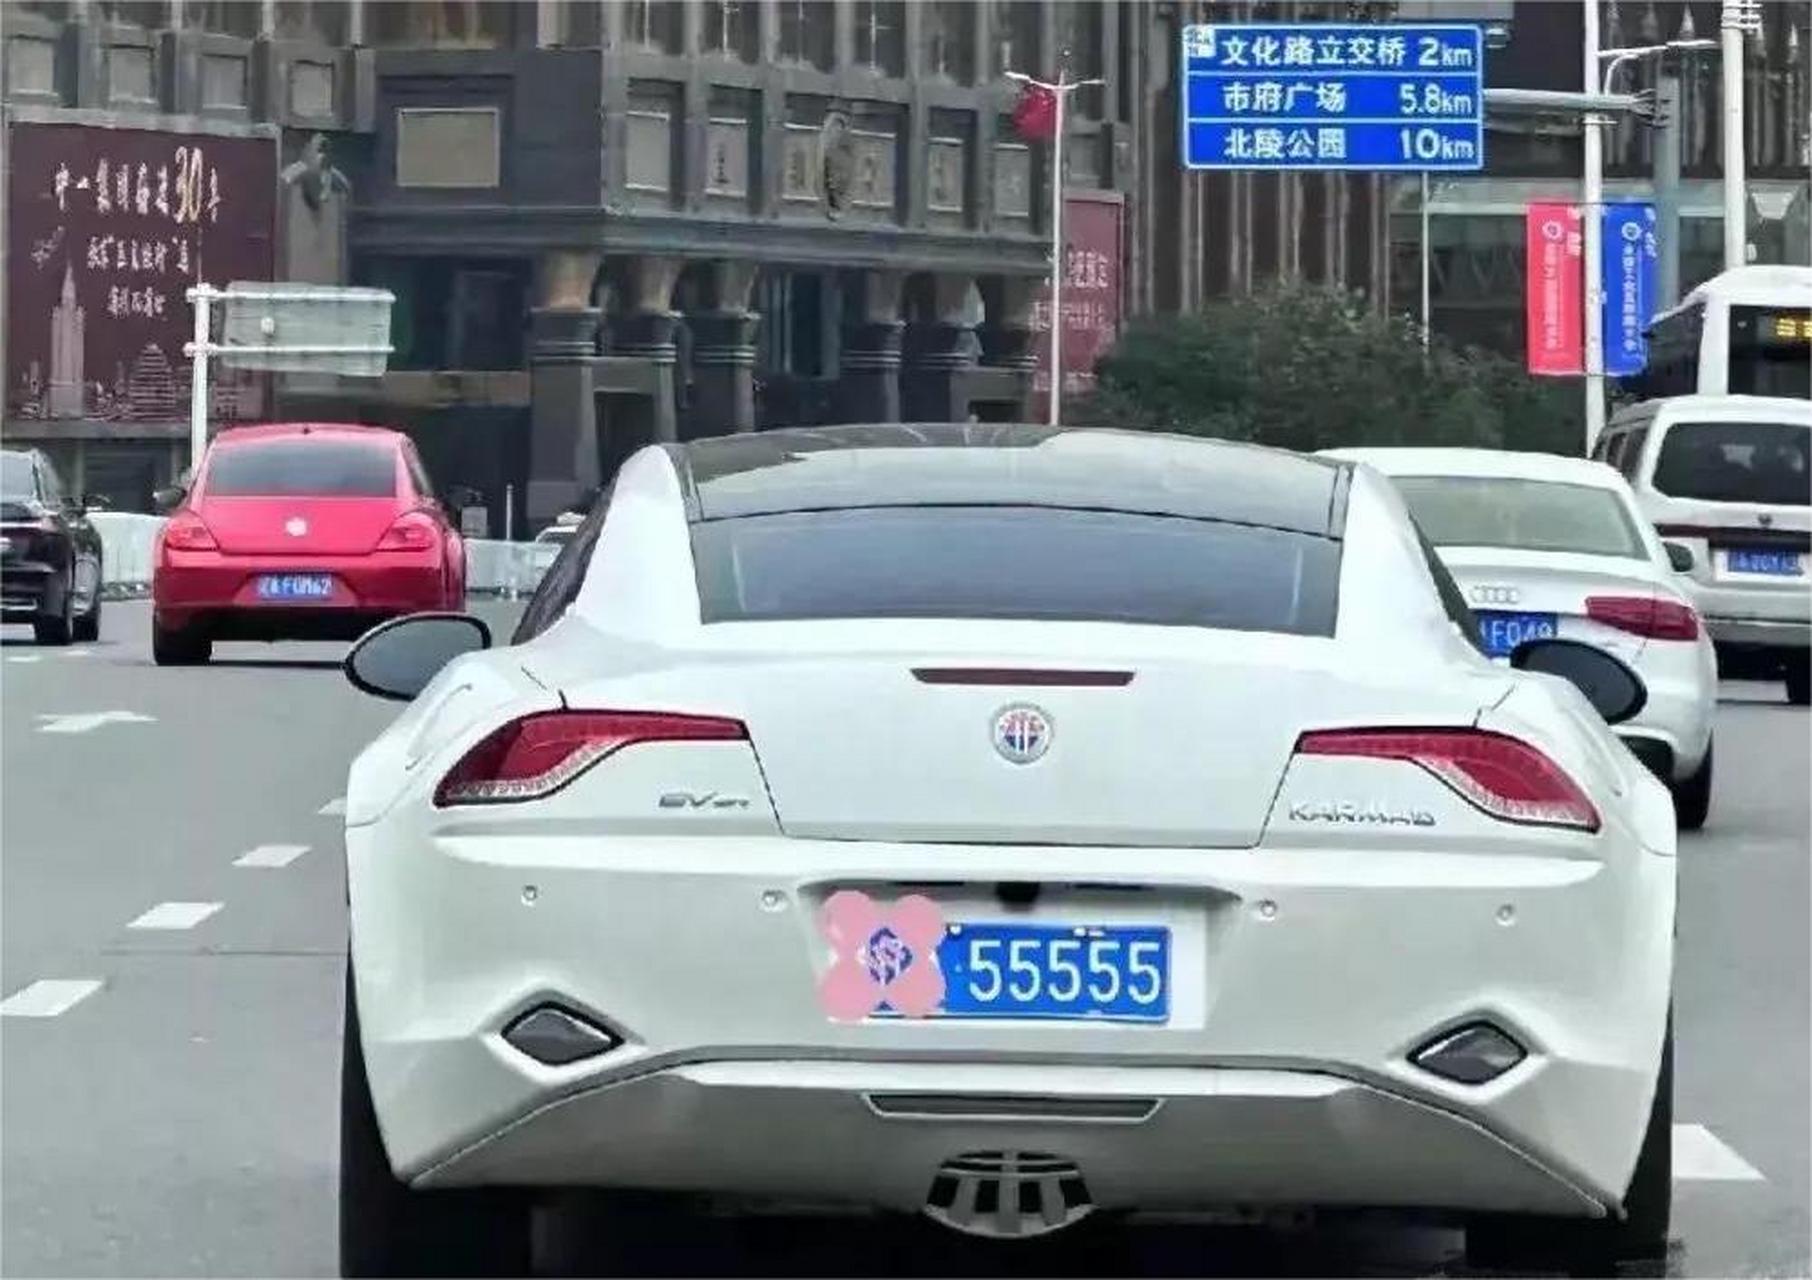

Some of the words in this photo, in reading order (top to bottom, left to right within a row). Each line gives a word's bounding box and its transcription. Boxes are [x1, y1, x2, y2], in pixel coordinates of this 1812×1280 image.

[1221, 36, 1405, 67] 文化路立交桥
[1418, 36, 1473, 67] 2km
[1222, 81, 1347, 113] 市府广场
[1400, 83, 1473, 115] 5.8km
[1223, 128, 1347, 160] 北陵公园
[1401, 128, 1475, 160] 10km
[968, 938, 1161, 1004] 55555
